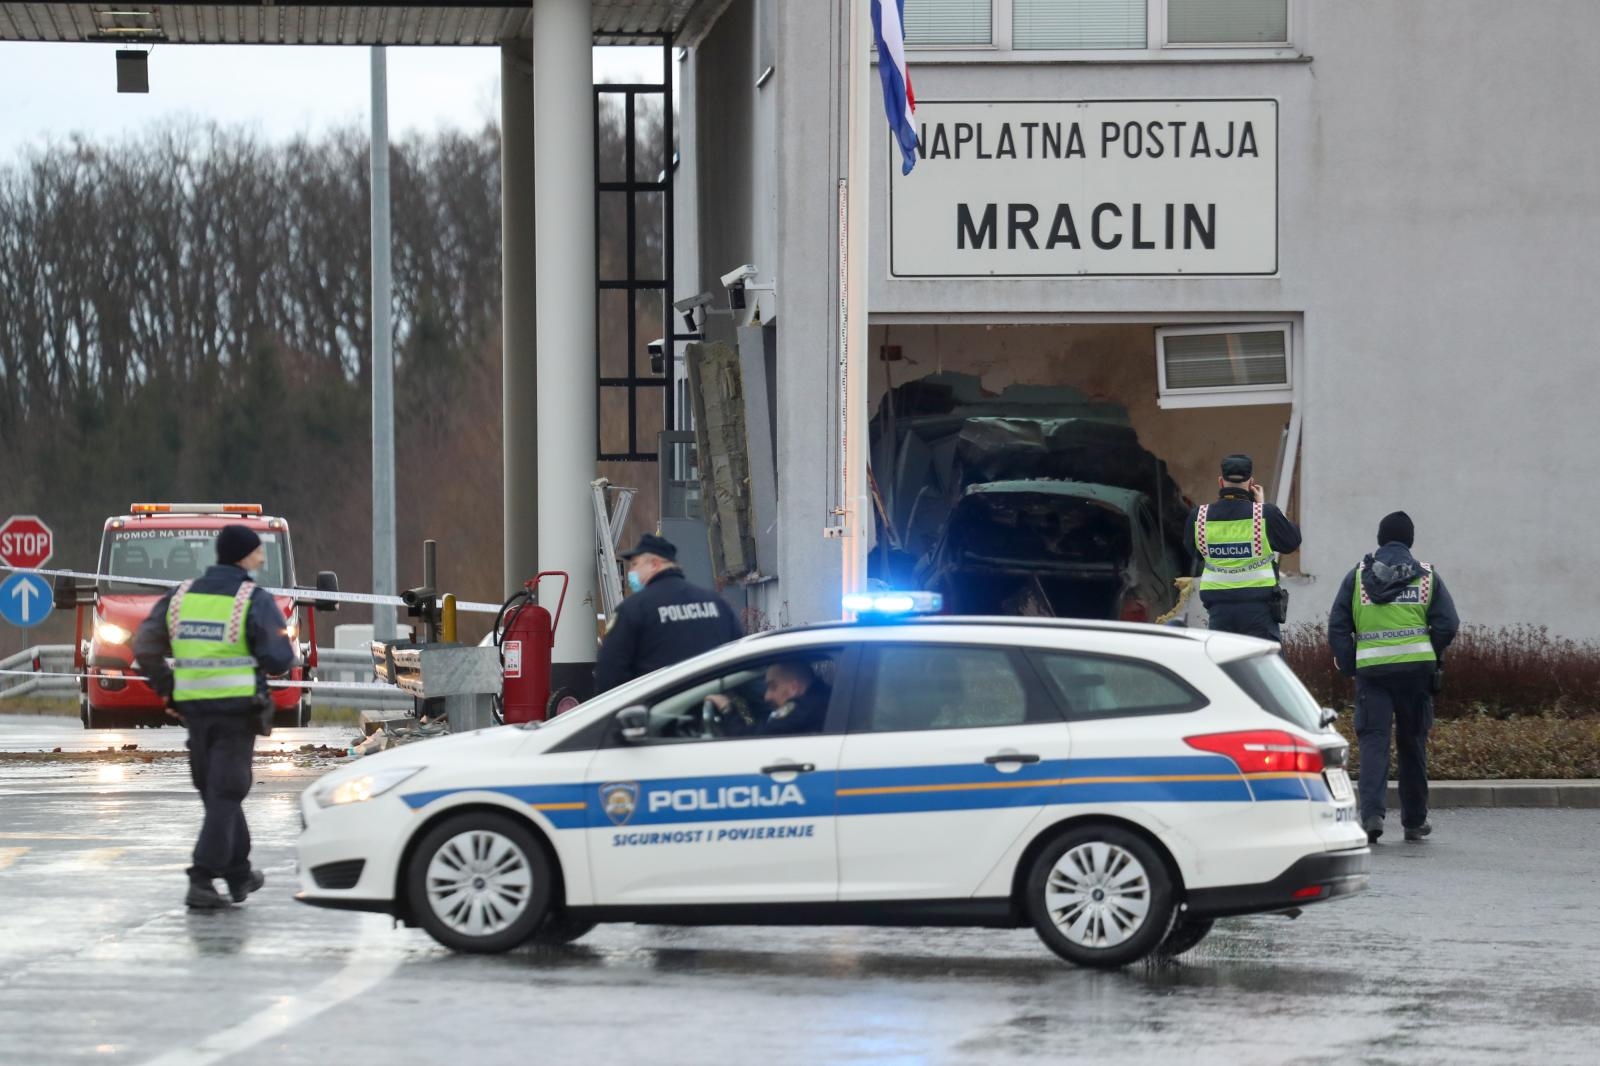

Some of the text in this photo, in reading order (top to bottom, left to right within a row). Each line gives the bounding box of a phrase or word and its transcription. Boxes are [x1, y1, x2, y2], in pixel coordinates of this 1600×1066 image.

[1101, 120, 1259, 159] POSTAJA
[956, 202, 1216, 250] MRACLIN
[2, 532, 49, 556] STOP
[160, 530, 175, 538] NA
[1209, 546, 1250, 556] POLICIJA
[658, 602, 719, 623] POLICIJA
[1382, 629, 1415, 638] POLICIJA
[648, 784, 806, 813] POLICIJA
[612, 824, 815, 847] SIGURNOST I POVJERENJE
